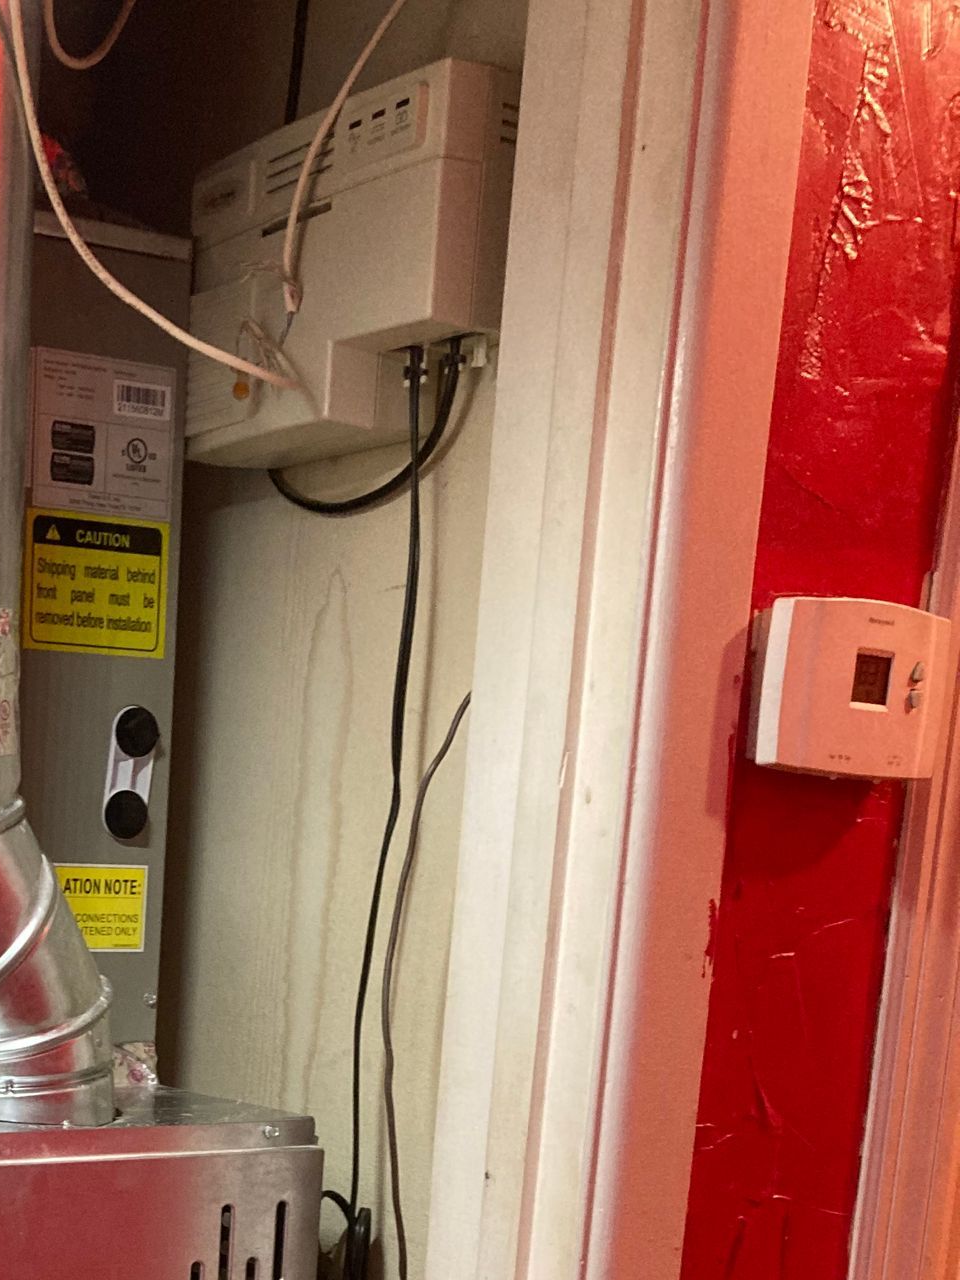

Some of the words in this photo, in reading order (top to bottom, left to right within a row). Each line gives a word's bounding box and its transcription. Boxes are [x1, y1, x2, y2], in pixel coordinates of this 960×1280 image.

[75, 529, 130, 549] CAUTION
[36, 556, 77, 581] Shipping
[83, 562, 119, 582] material
[126, 566, 156, 585] behind
[36, 583, 58, 601] front
[70, 587, 95, 605] panel
[108, 591, 130, 607] must
[143, 592, 155, 608] be
[35, 608, 75, 629] removed
[75, 610, 105, 630] before
[105, 613, 152, 634] installation
[104, 879, 142, 895] NOTE:
[76, 913, 139, 923] CONNECTIONS
[81, 926, 113, 936] TENED
[114, 926, 137, 936] ONLY
